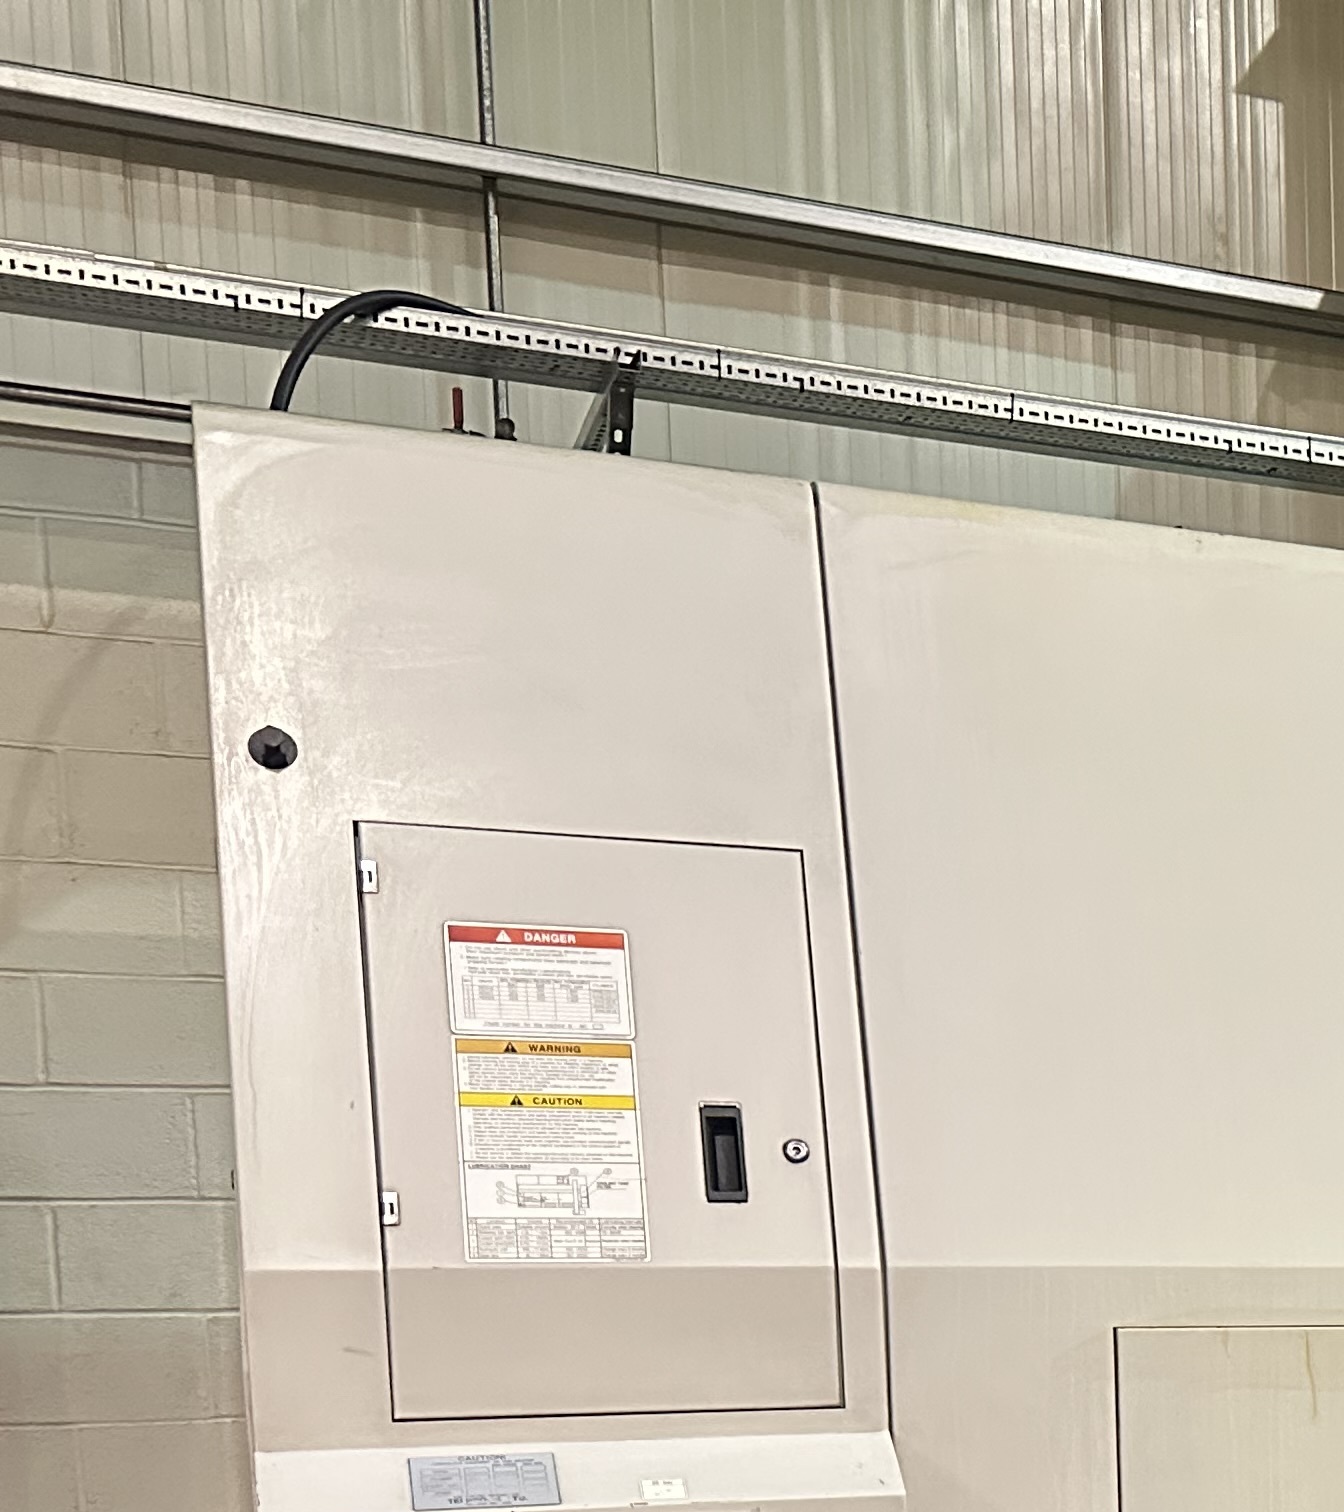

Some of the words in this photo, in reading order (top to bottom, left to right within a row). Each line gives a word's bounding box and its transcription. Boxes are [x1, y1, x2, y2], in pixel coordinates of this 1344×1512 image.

[523, 931, 577, 945] DANGER
[528, 1043, 582, 1054] WARNING
[532, 1097, 583, 1106] CAUTION
